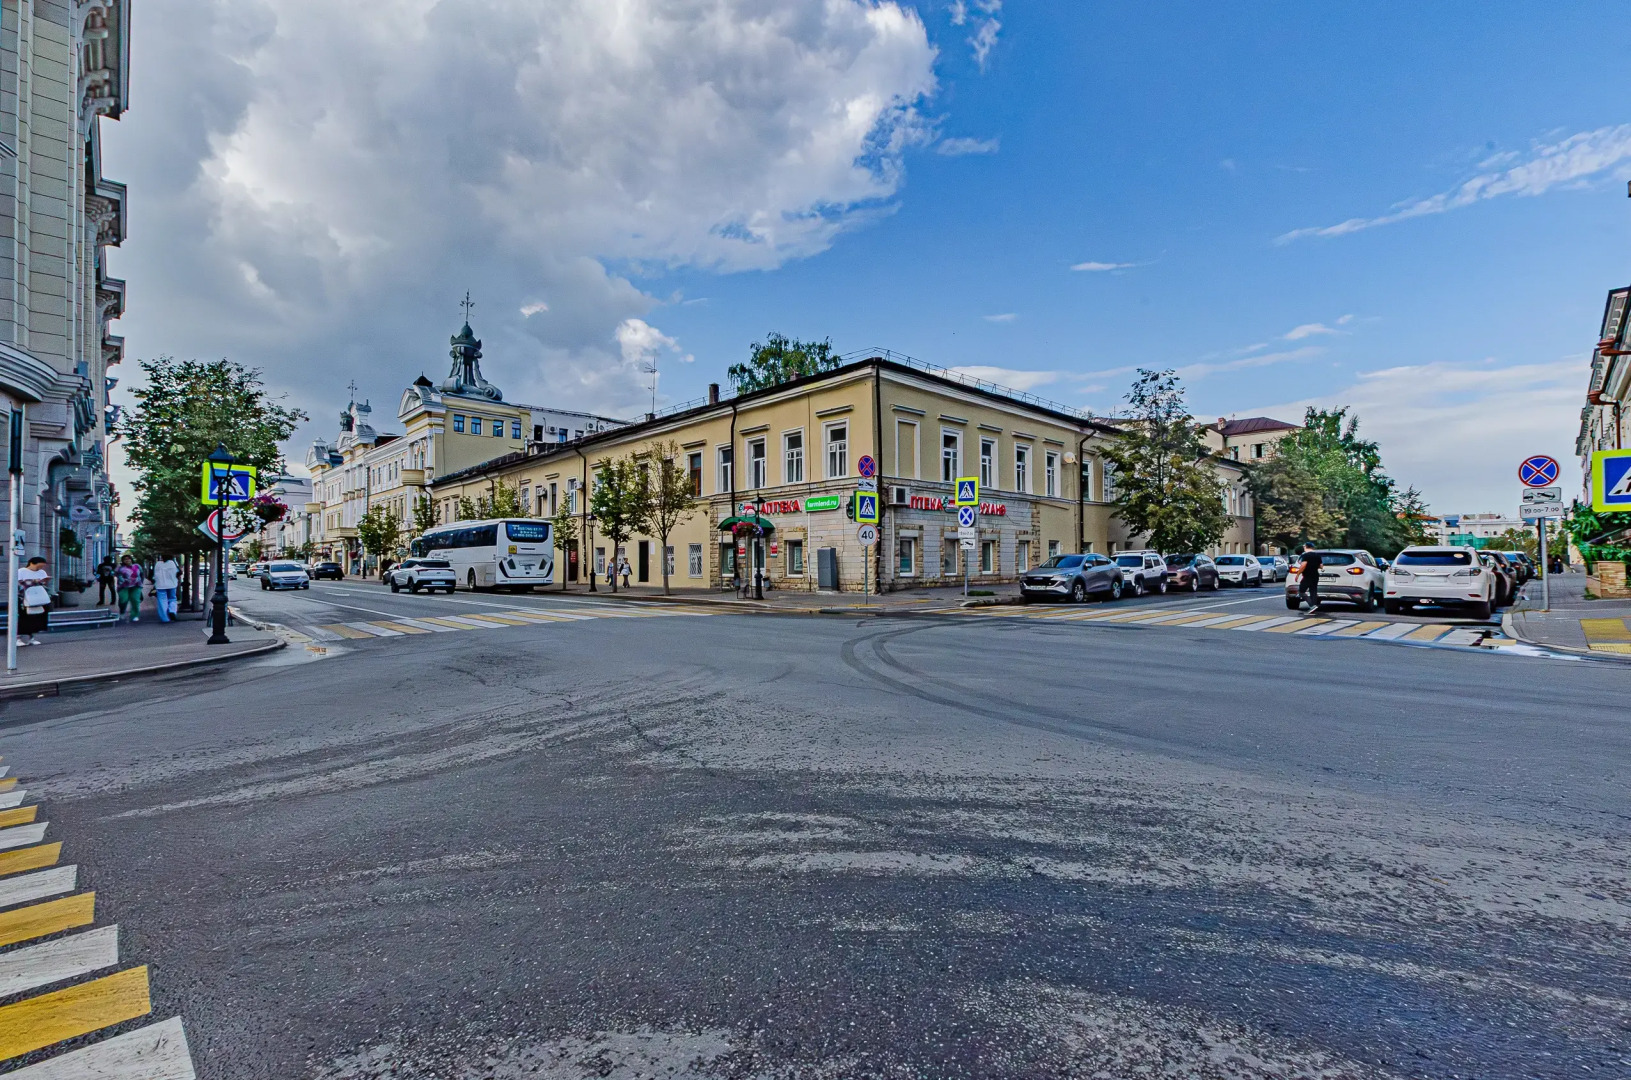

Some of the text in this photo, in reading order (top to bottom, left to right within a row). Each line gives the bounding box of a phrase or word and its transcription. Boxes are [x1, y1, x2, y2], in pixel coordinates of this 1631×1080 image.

[760, 499, 801, 514] АПТЕКА
[908, 496, 944, 511] ПТЕКА
[861, 530, 874, 540] 40
